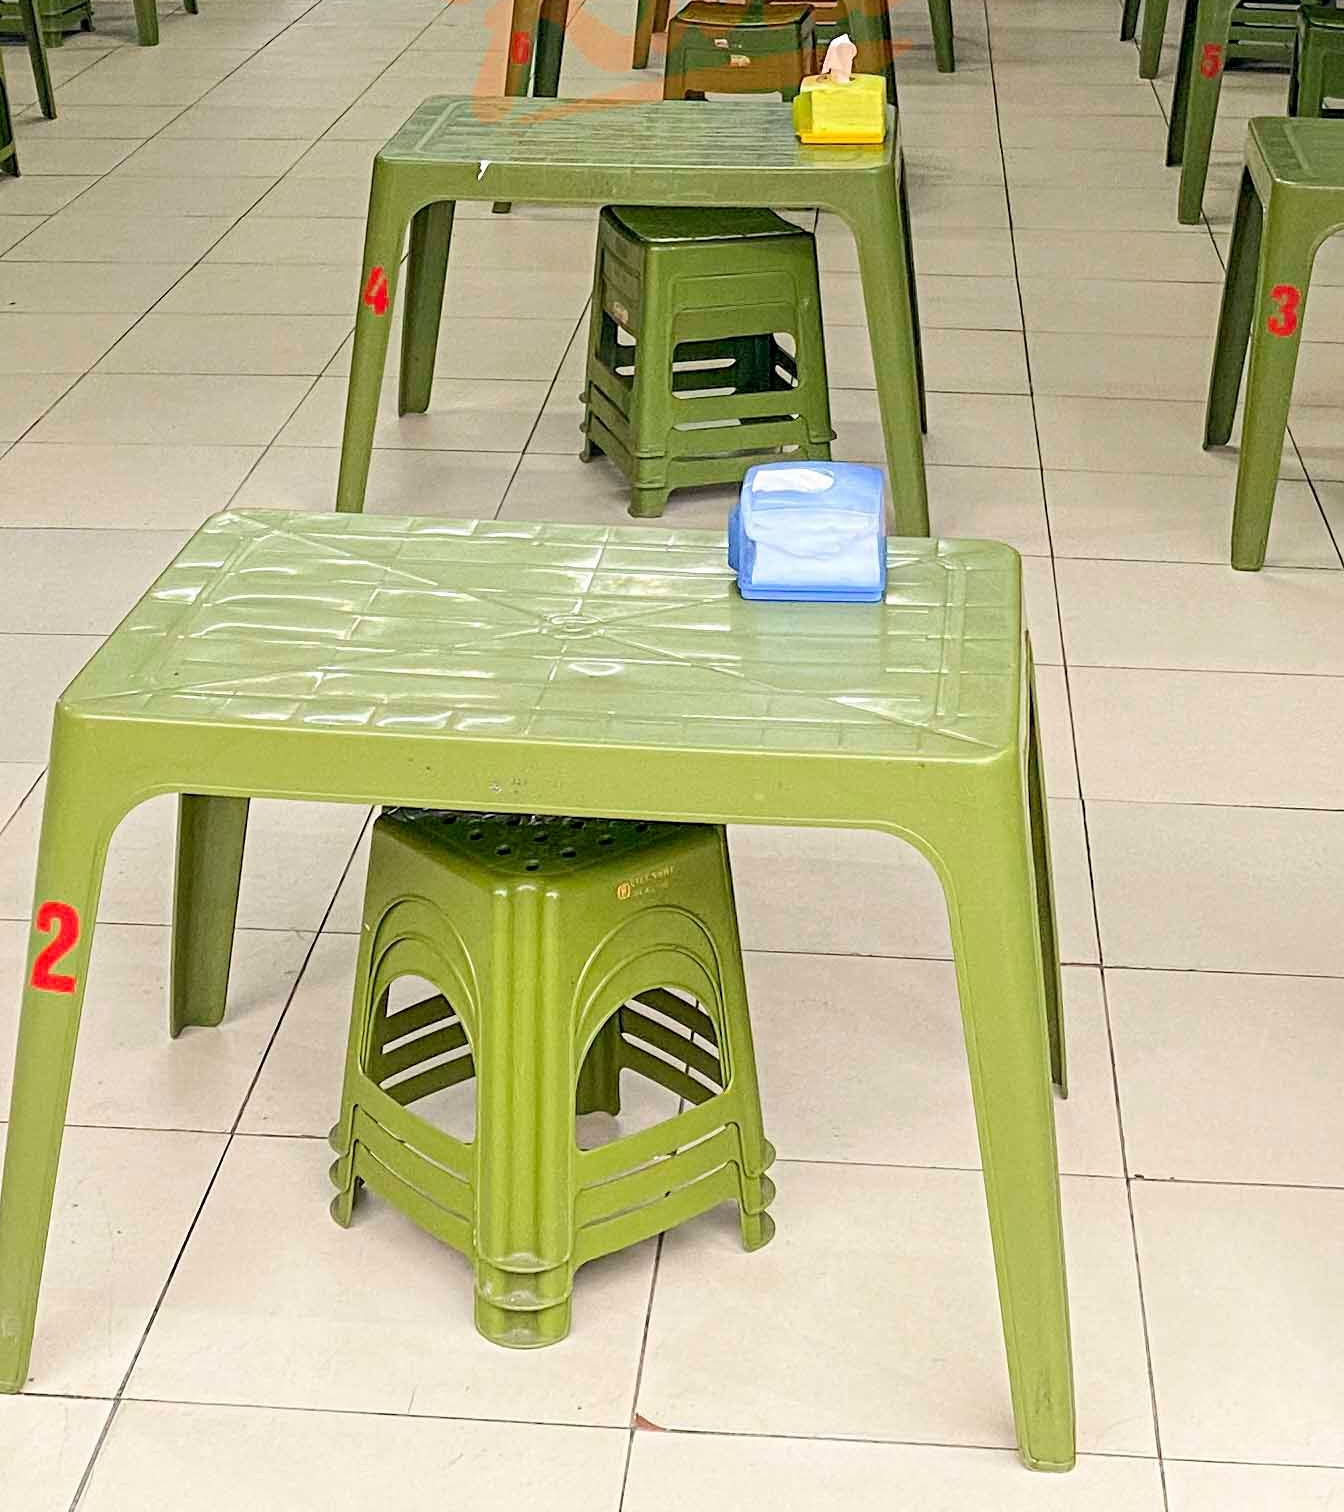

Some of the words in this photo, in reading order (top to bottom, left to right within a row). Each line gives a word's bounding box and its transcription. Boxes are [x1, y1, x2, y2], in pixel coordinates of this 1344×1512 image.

[1199, 44, 1223, 79] 5
[363, 266, 390, 317] 4
[1267, 284, 1302, 337] 3
[31, 900, 80, 994] 2
